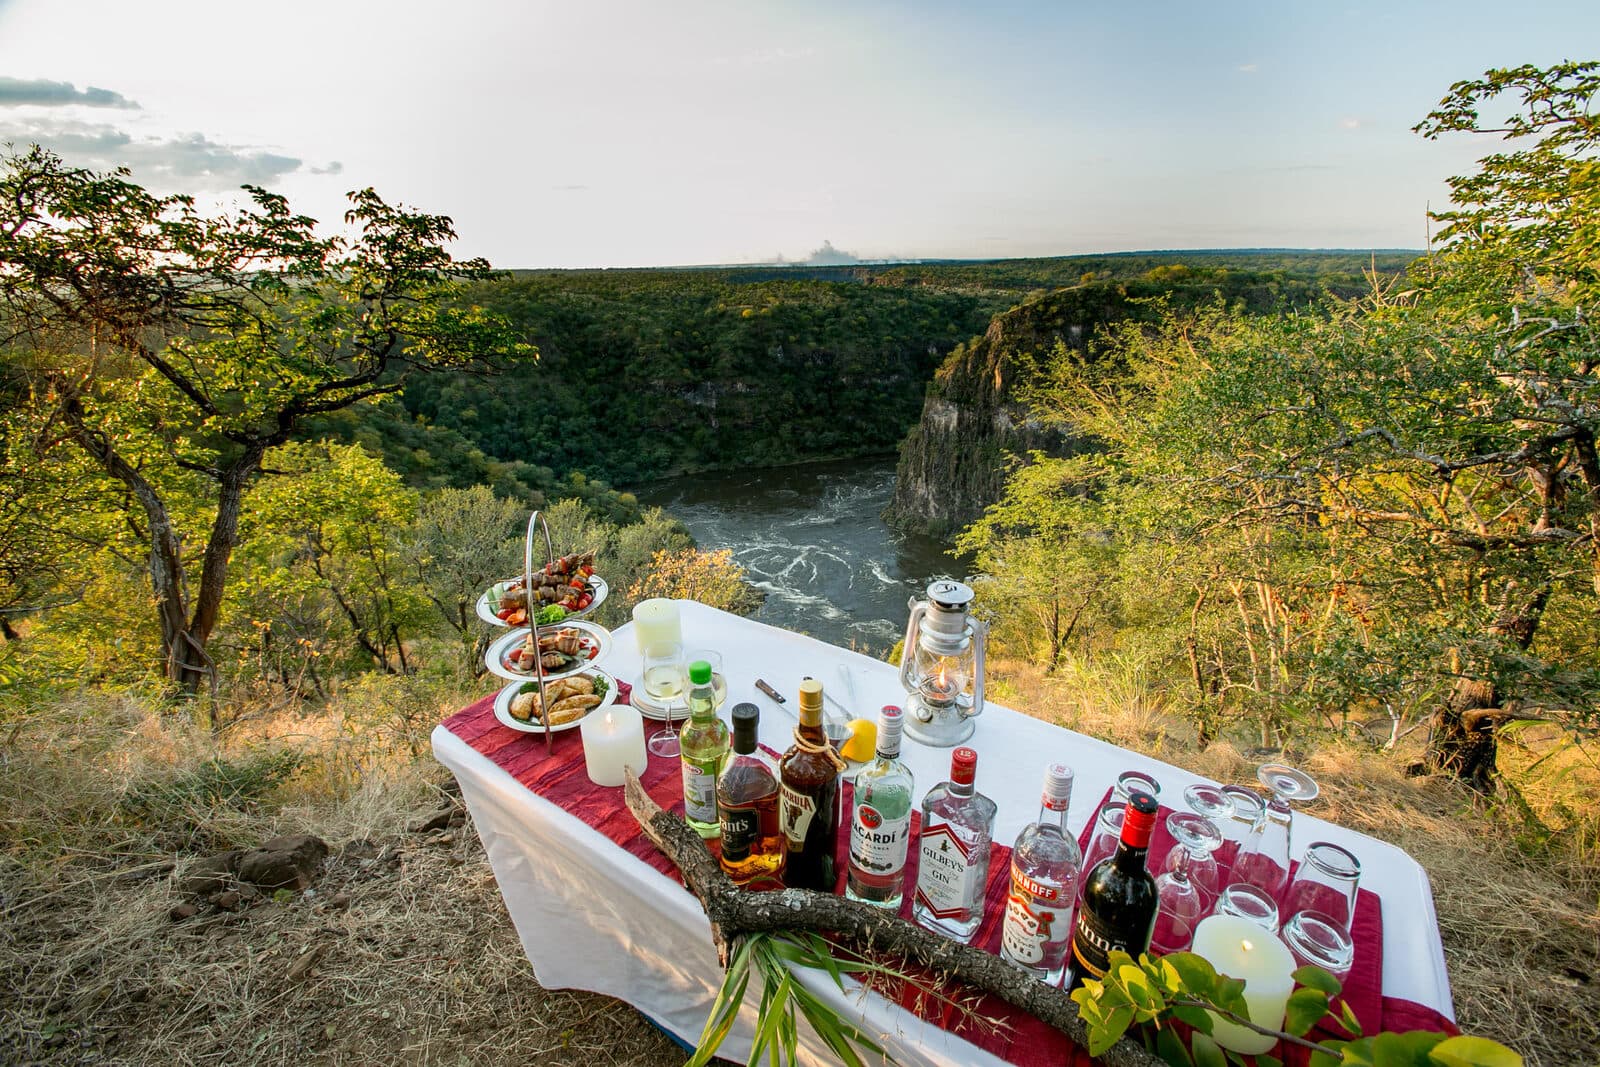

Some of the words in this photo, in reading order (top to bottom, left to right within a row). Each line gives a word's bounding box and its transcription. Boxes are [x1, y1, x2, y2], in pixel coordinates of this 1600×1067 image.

[780, 786, 813, 812] MARULA
[719, 817, 749, 832] ant's
[852, 819, 896, 844] ACARDÍ
[923, 846, 964, 873] GILBEY'S
[932, 870, 950, 884] GIN
[1011, 863, 1053, 898] IRNOFF
